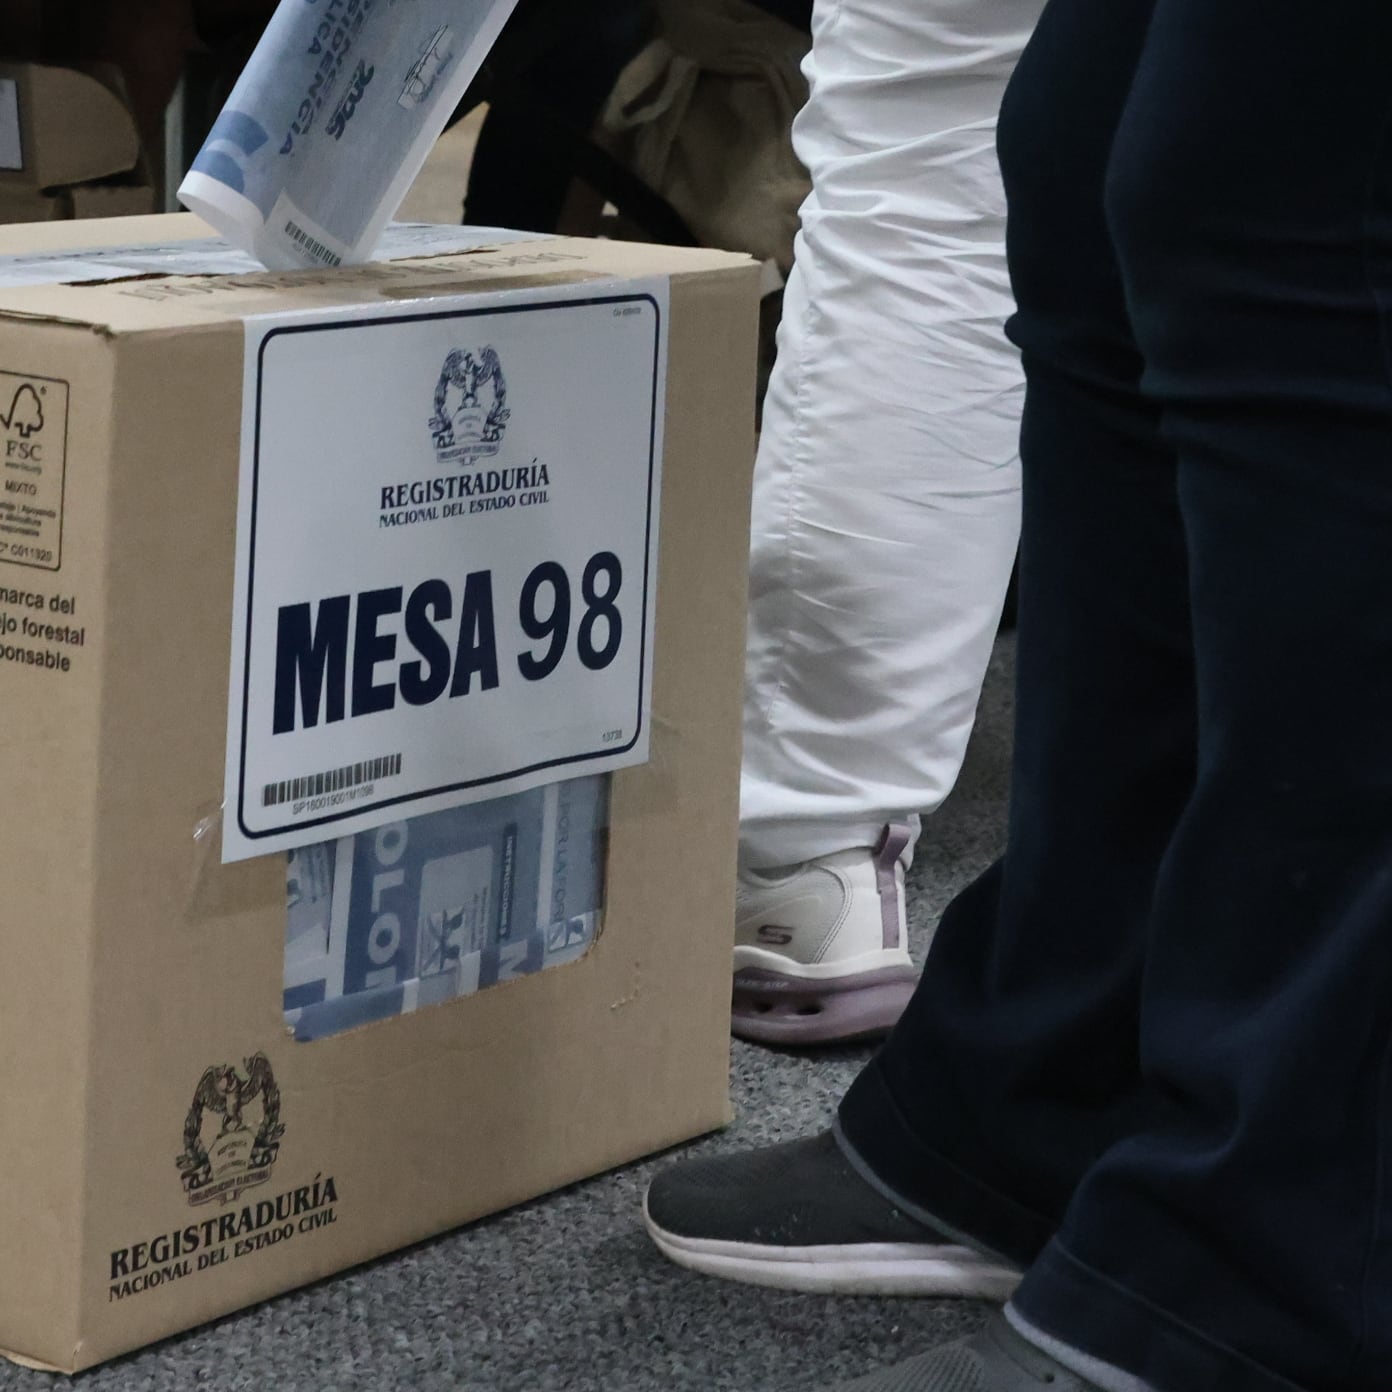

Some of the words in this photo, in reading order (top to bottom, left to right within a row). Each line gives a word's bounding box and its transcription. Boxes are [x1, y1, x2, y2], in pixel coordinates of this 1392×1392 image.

[6, 440, 42, 461] FSC
[5, 480, 37, 496] MIXTO
[380, 458, 550, 509] REGISTRADURÍA
[379, 504, 439, 528] NACIONAL
[442, 502, 465, 518] DEL
[469, 495, 515, 514] ESTADO
[519, 490, 549, 506] CIVIL
[49, 594, 75, 615] del
[22, 617, 85, 646] forestal
[273, 570, 499, 735] MESA
[517, 551, 622, 681] 98
[110, 1172, 339, 1280] REGISTRADURÍA
[109, 1260, 193, 1302] NACIONAL
[197, 1248, 230, 1271] DEL
[234, 1222, 294, 1258] ESTADO
[298, 1207, 337, 1233] CIVIL
